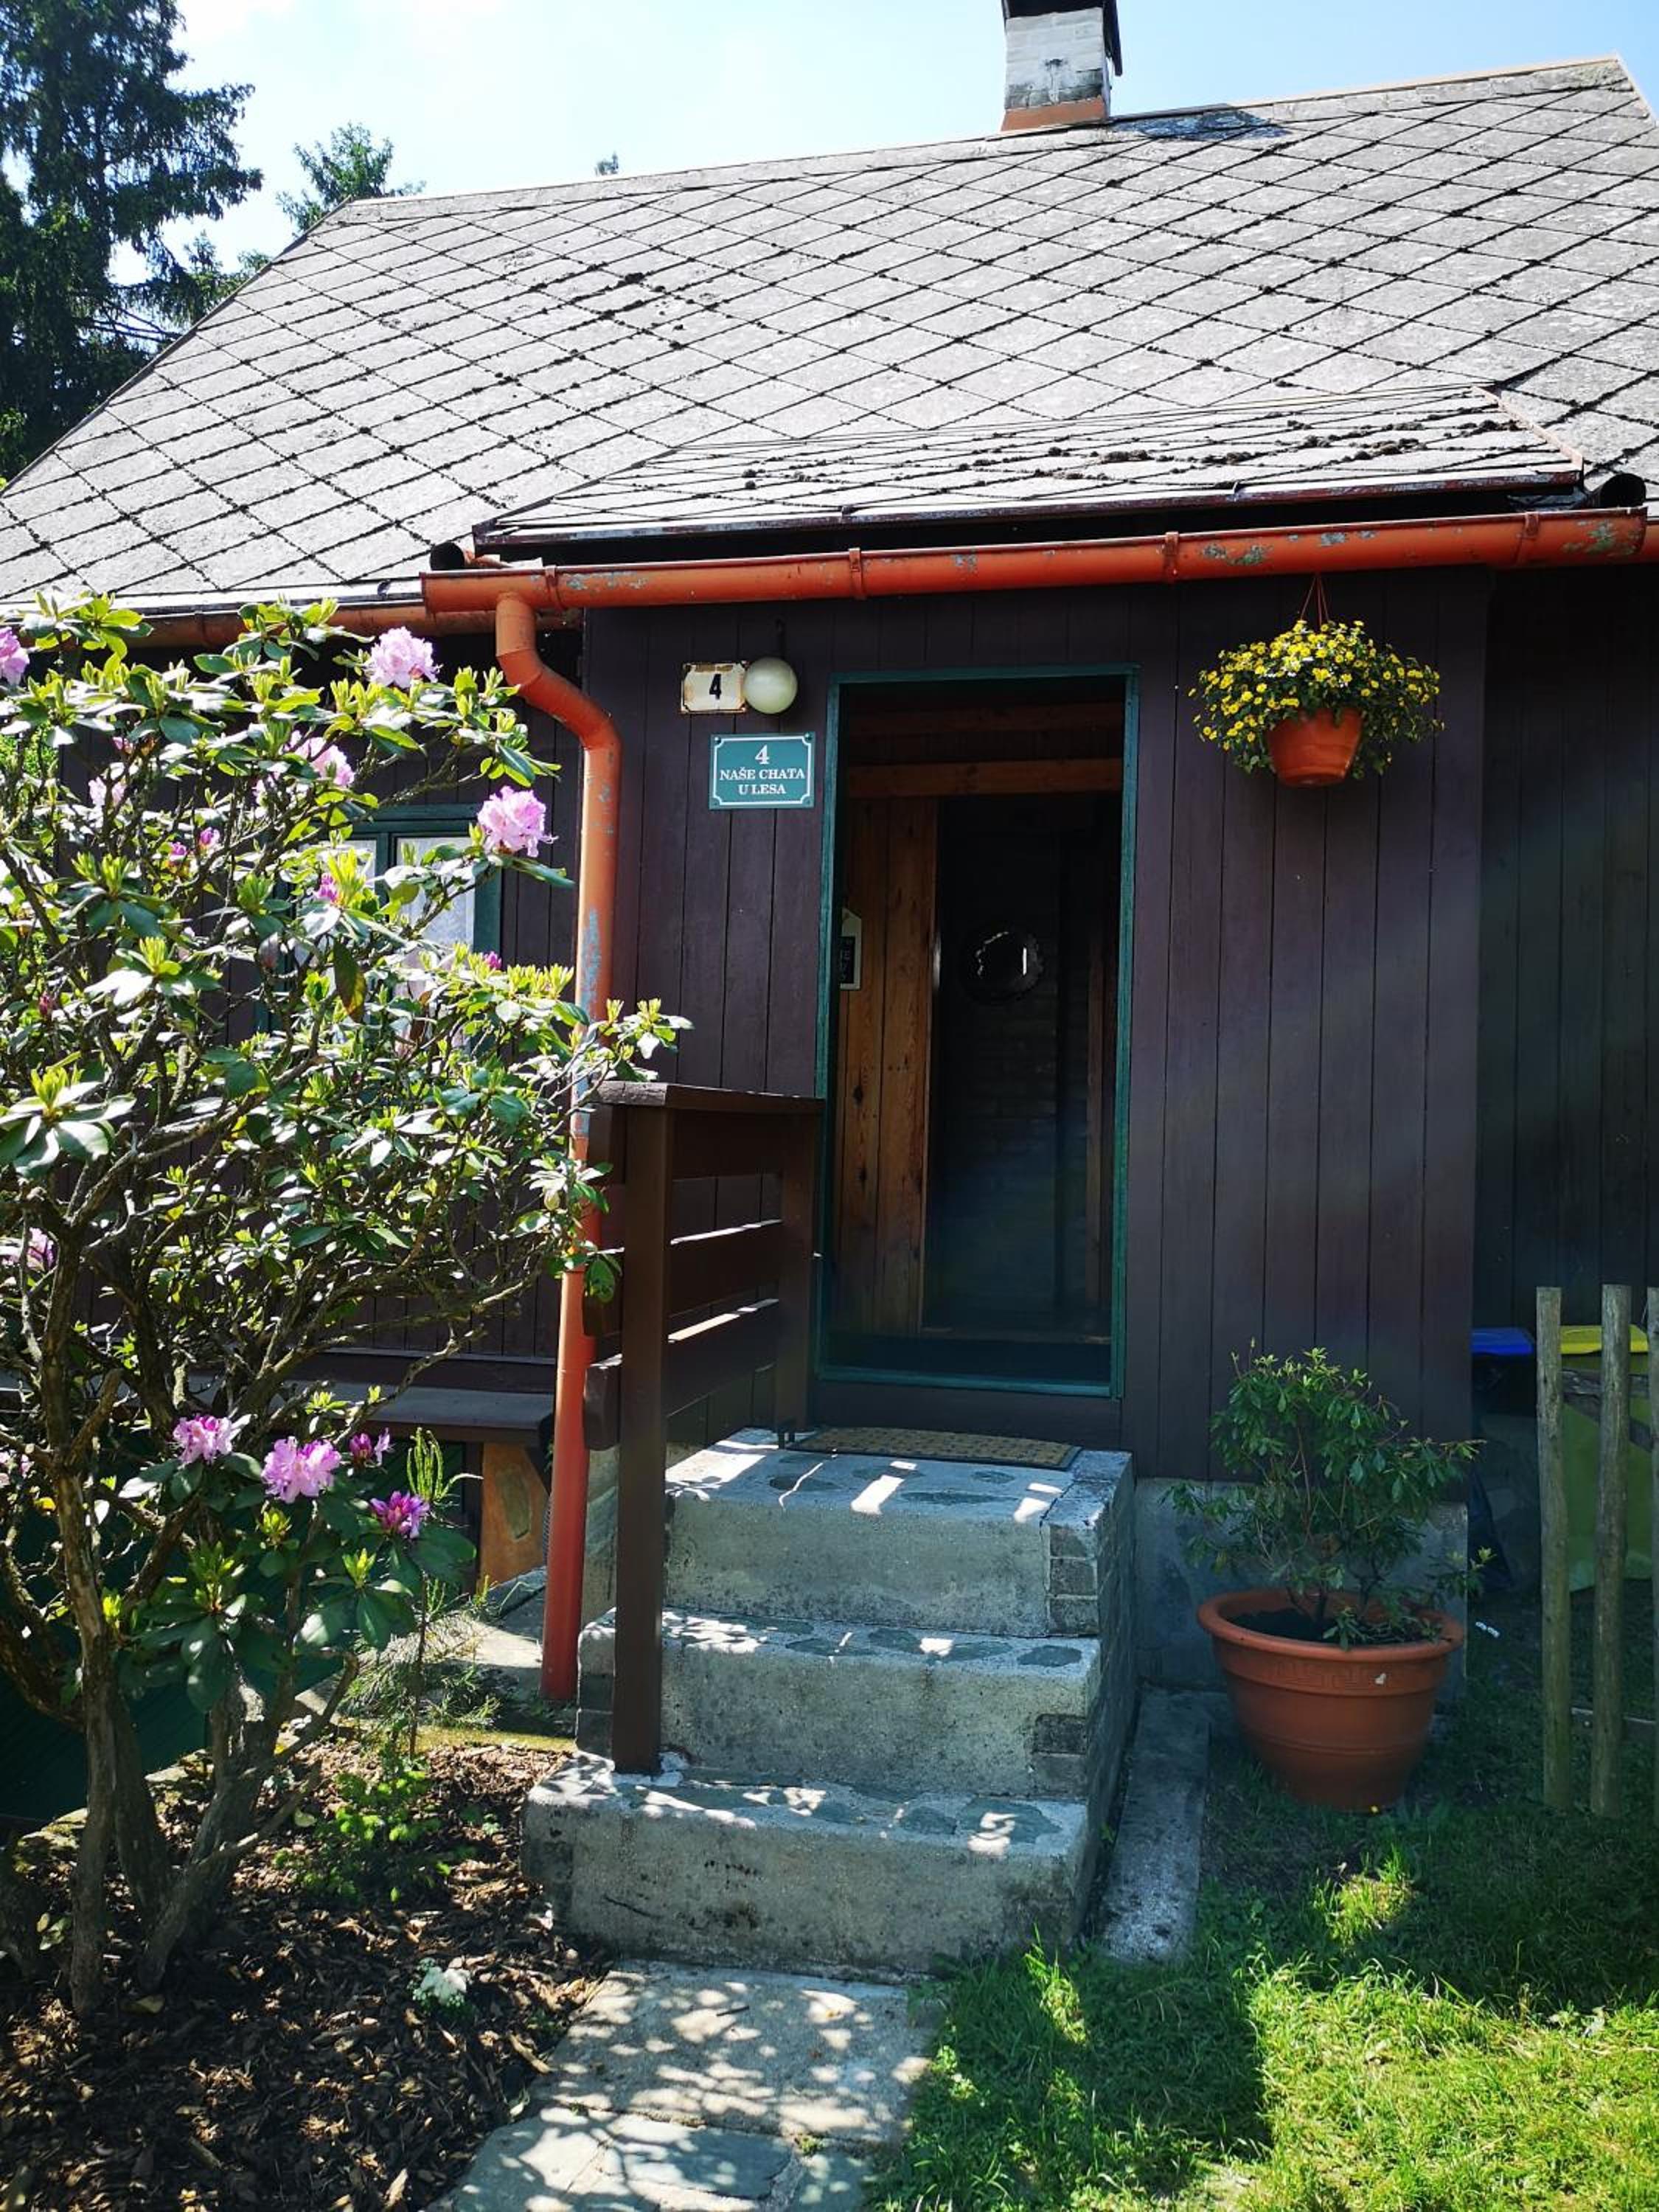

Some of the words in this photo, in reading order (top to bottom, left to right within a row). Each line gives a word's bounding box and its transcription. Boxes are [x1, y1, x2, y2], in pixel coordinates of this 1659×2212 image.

[709, 673, 722, 700] 4
[754, 745, 770, 765] 4
[719, 767, 756, 781] NAŠE
[759, 768, 805, 779] CHATA
[738, 784, 749, 795] U
[751, 784, 787, 794] LESA
